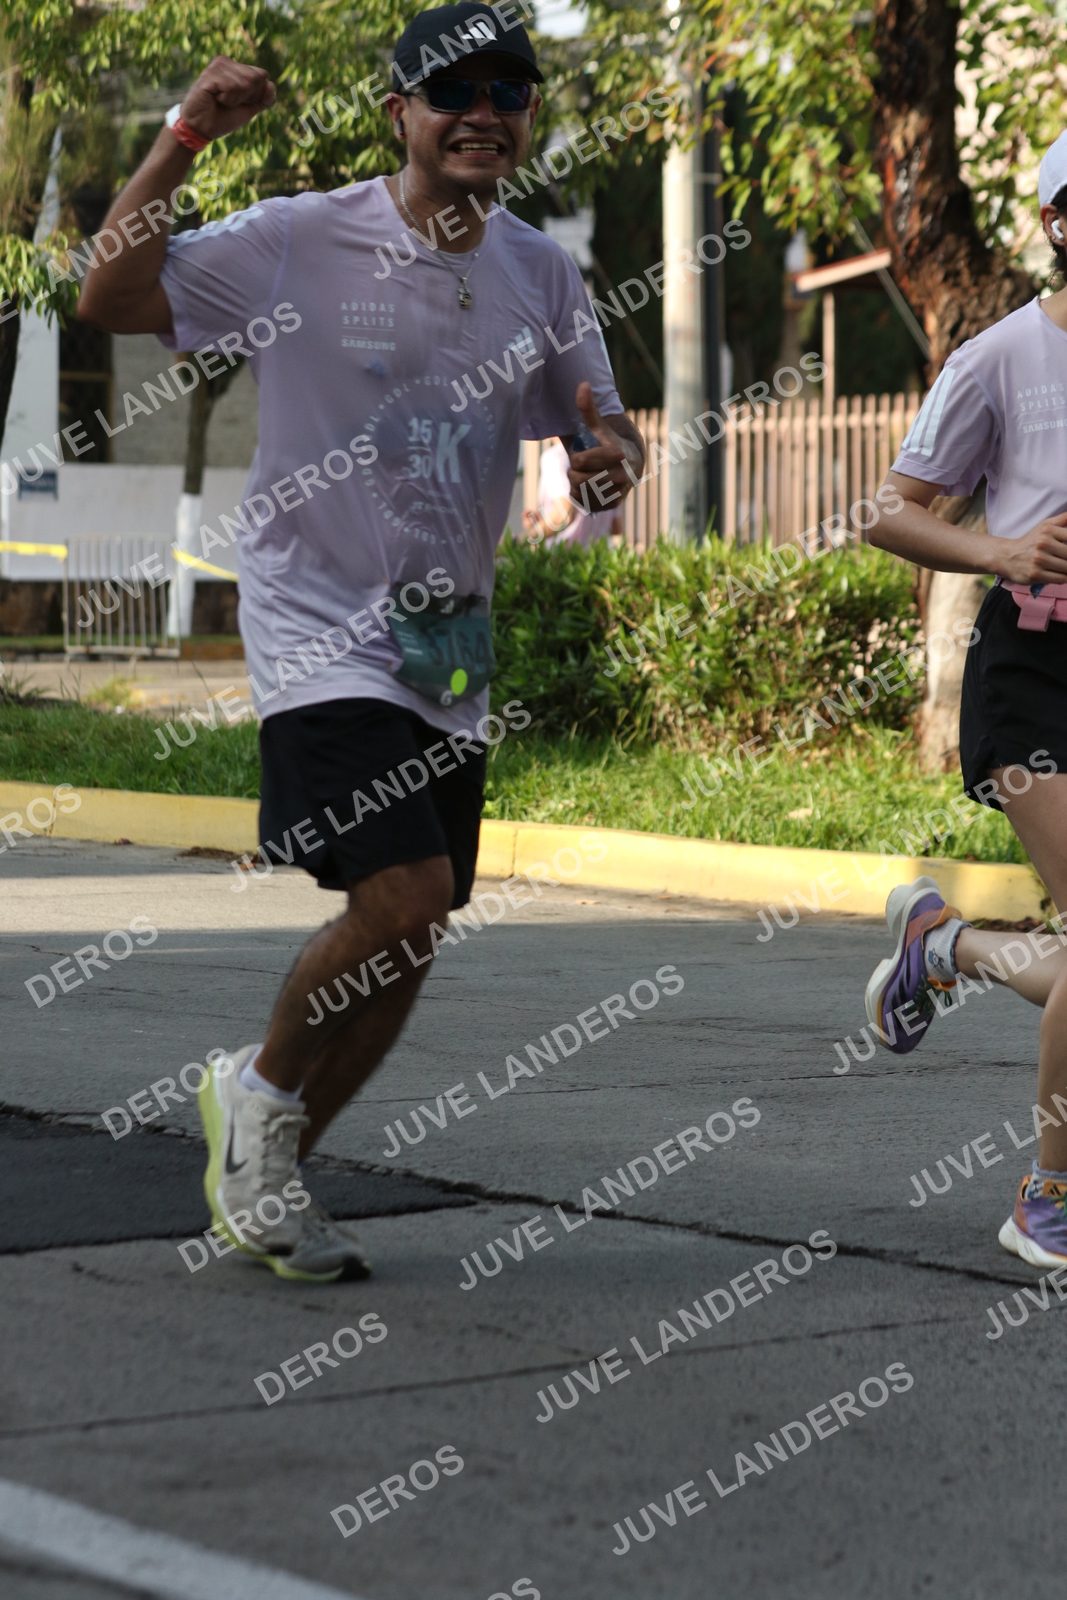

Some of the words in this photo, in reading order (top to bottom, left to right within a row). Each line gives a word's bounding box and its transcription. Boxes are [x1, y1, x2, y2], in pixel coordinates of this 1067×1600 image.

[340, 302, 396, 313] ADIDAS
[341, 315, 395, 327] SPLITS
[341, 338, 396, 351] SAMSUNG
[407, 417, 433, 444] 15
[436, 422, 472, 484] K
[407, 454, 433, 480] 30
